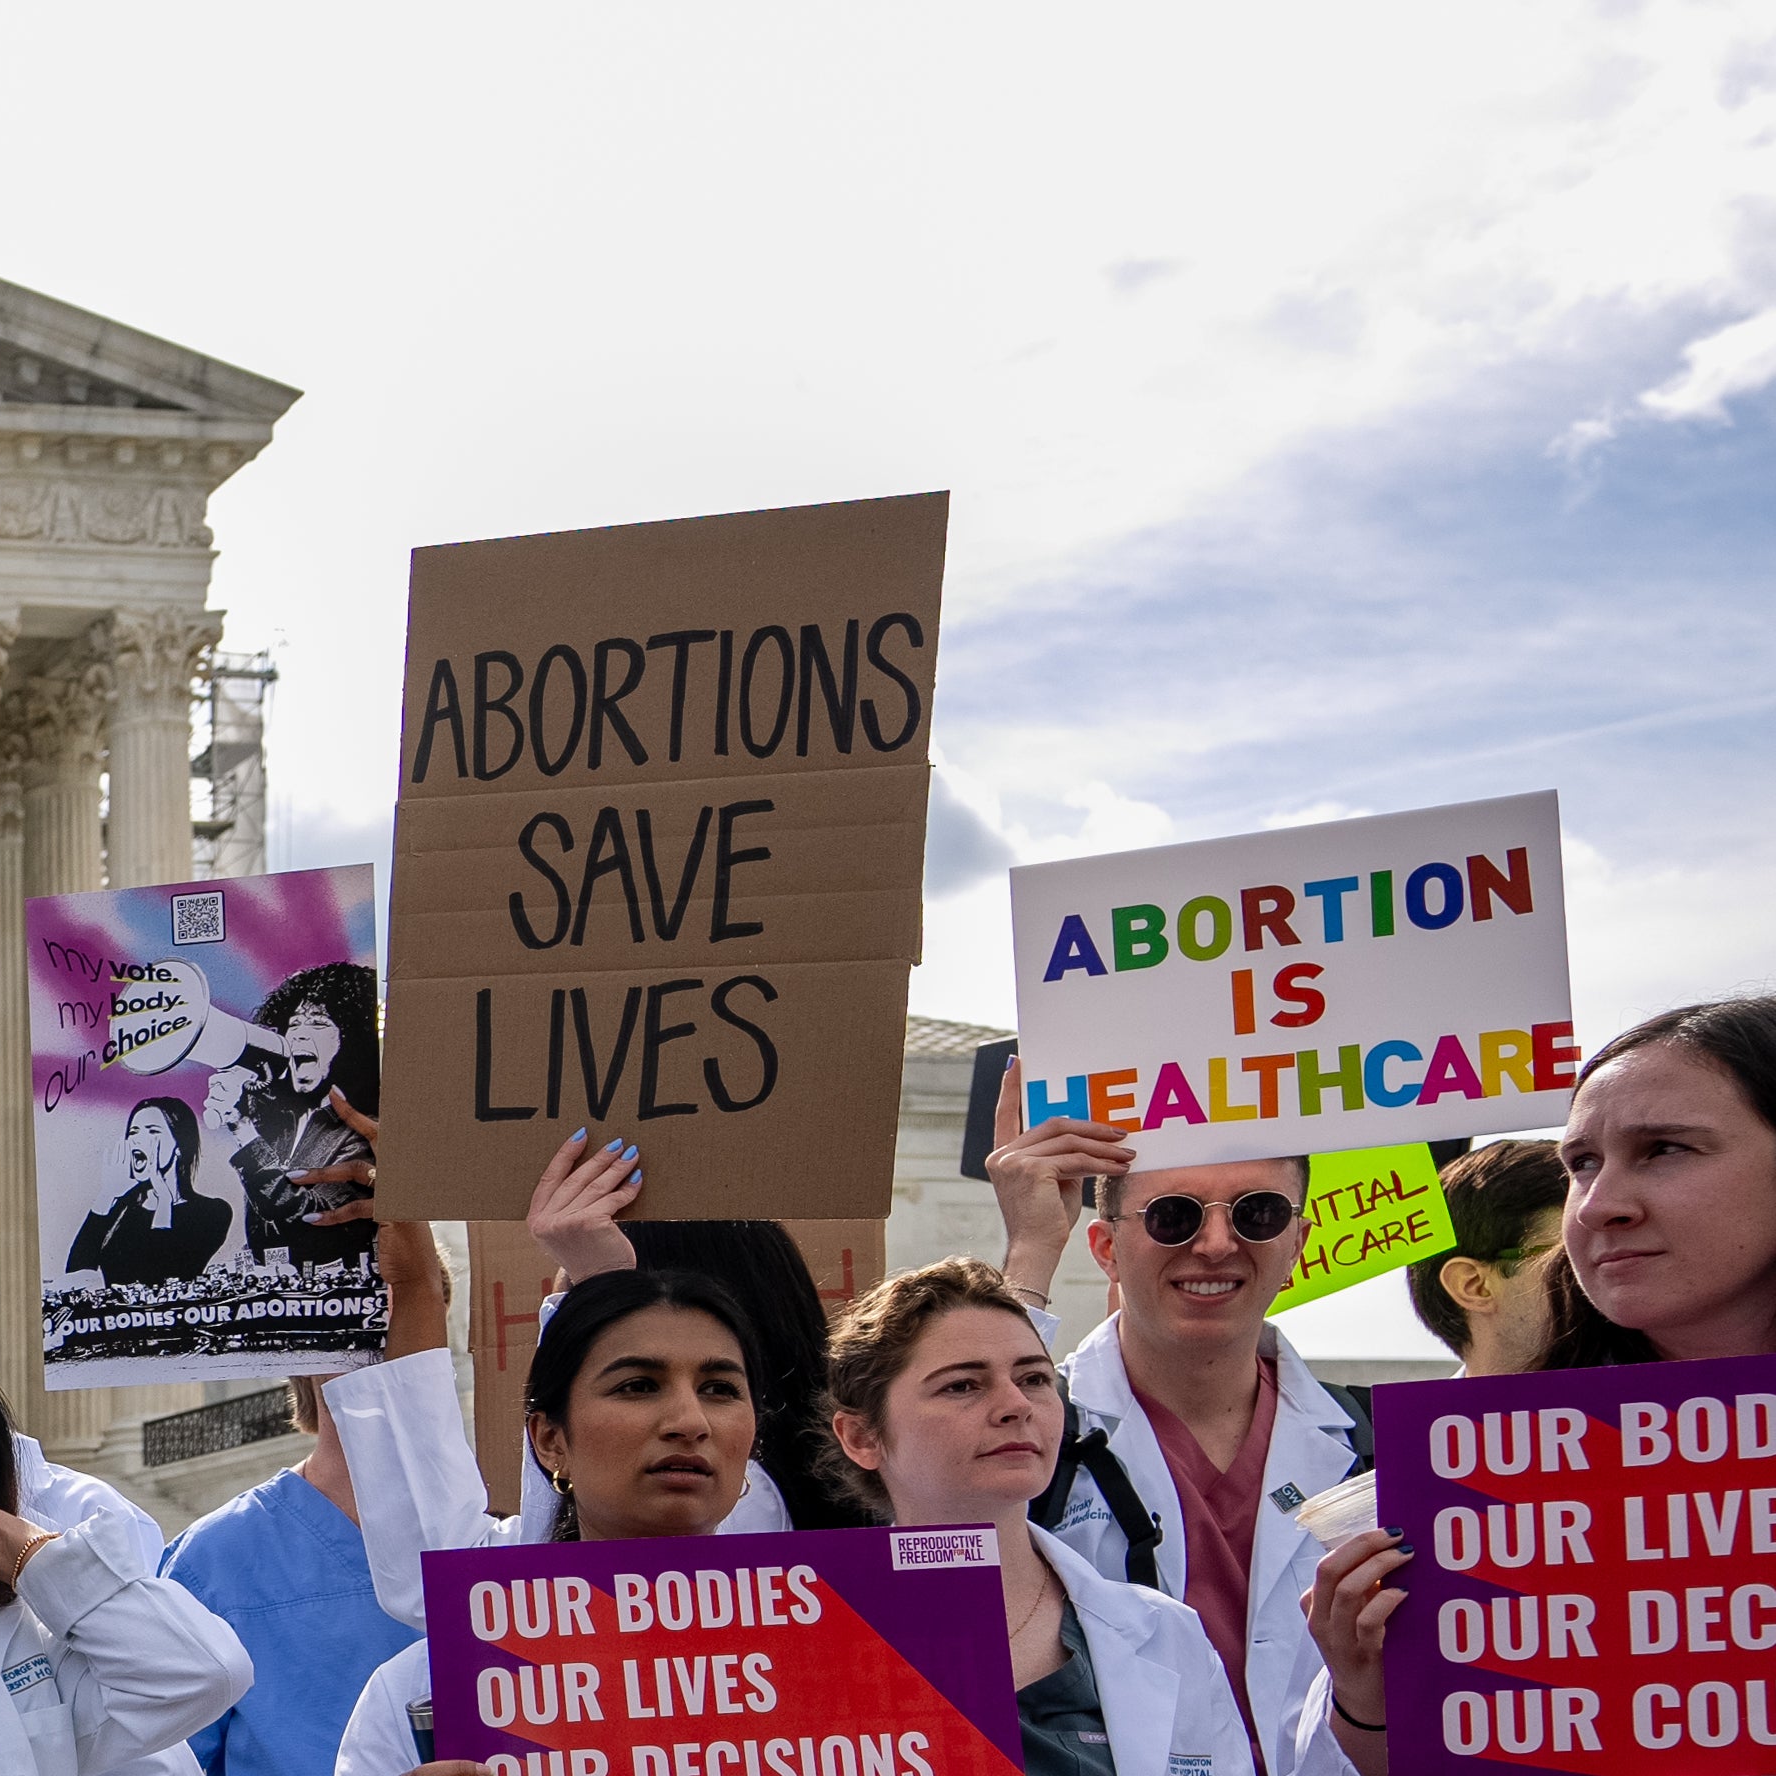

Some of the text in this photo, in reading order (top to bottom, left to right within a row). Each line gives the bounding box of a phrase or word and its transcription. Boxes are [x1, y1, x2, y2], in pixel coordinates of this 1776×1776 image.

[411, 612, 924, 783] ABORTIONS
[509, 799, 776, 950] SAVE
[1042, 846, 1533, 983] ABORTION
[42, 937, 180, 984] my vote.
[1230, 962, 1326, 1036] IS
[58, 990, 186, 1031] my body.
[474, 975, 778, 1122] LIVES
[44, 1013, 192, 1114] our choice.
[1026, 1020, 1580, 1133] HEALTHCARE
[60, 1297, 374, 1336] OUR BODIES OUR ABORTIONS
[1429, 1392, 1776, 1480] OUR BOD
[898, 1534, 984, 1552] REPRODUCTIVE
[899, 1545, 985, 1565] FREEDOM FOR ALL
[1433, 1487, 1776, 1572] OUR LIVE
[469, 1564, 823, 1642] OUR BODIES
[1438, 1583, 1776, 1664] OUR DEC
[477, 1652, 778, 1729] OUR LIVES
[1442, 1687, 1603, 1756] OUR
